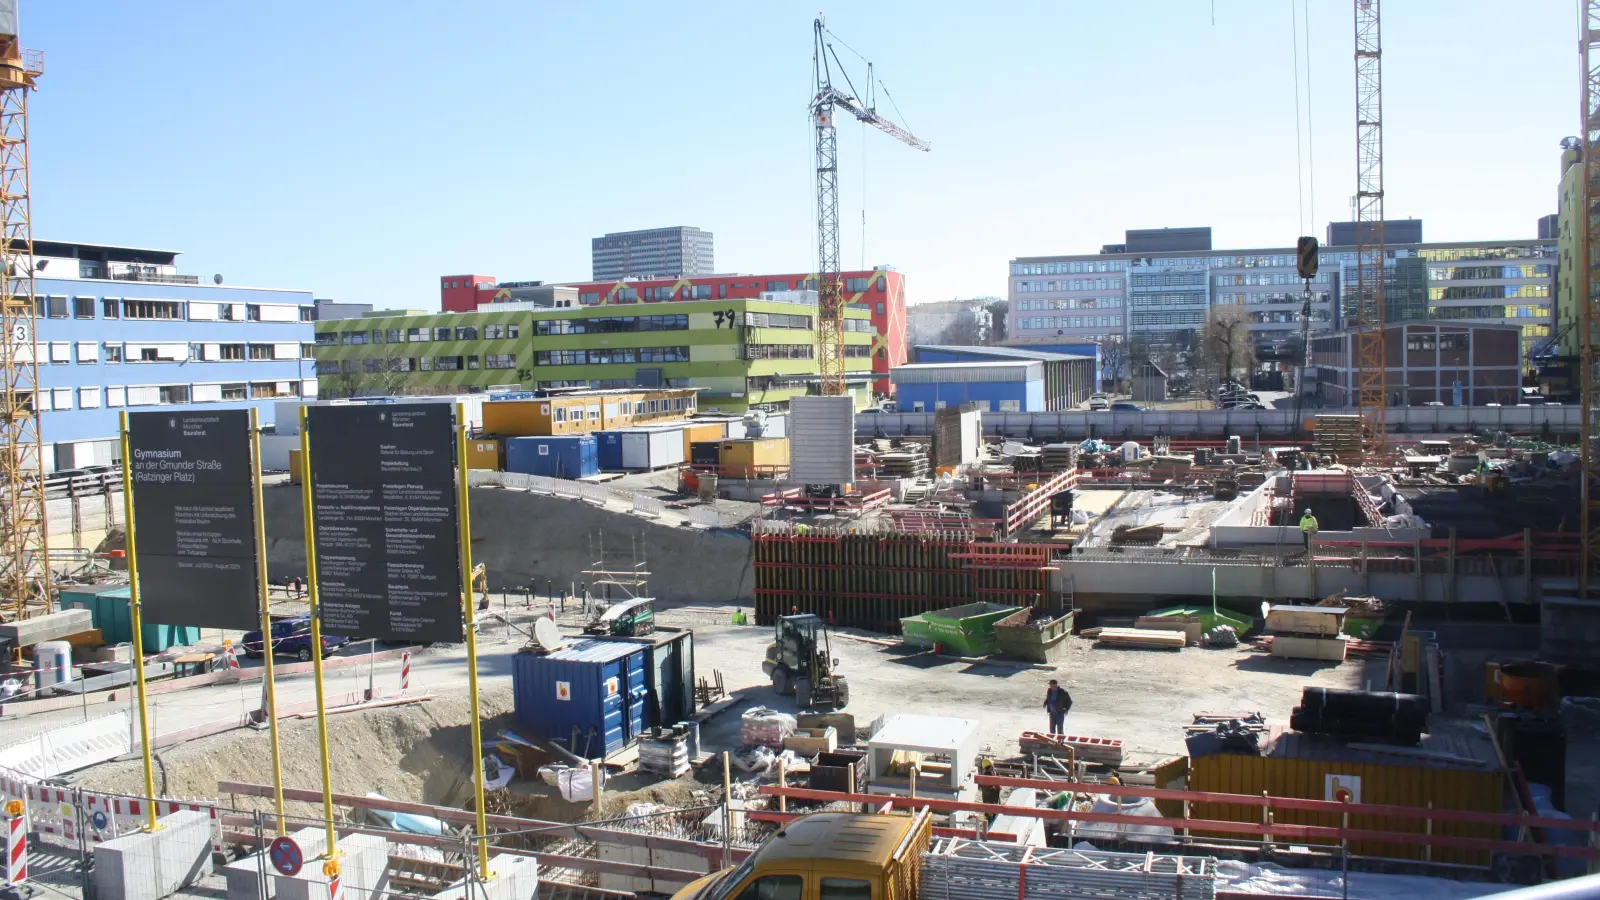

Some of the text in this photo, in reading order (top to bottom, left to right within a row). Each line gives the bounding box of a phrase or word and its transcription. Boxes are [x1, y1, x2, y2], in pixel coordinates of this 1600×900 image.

[713, 308, 736, 330] 79
[15, 324, 27, 342] 3
[134, 449, 181, 459] Gymnasium
[146, 460, 158, 469] der
[160, 460, 195, 469] Gmunder
[196, 460, 221, 470] Straße
[136, 472, 195, 483] (Ratzinger Platz)
